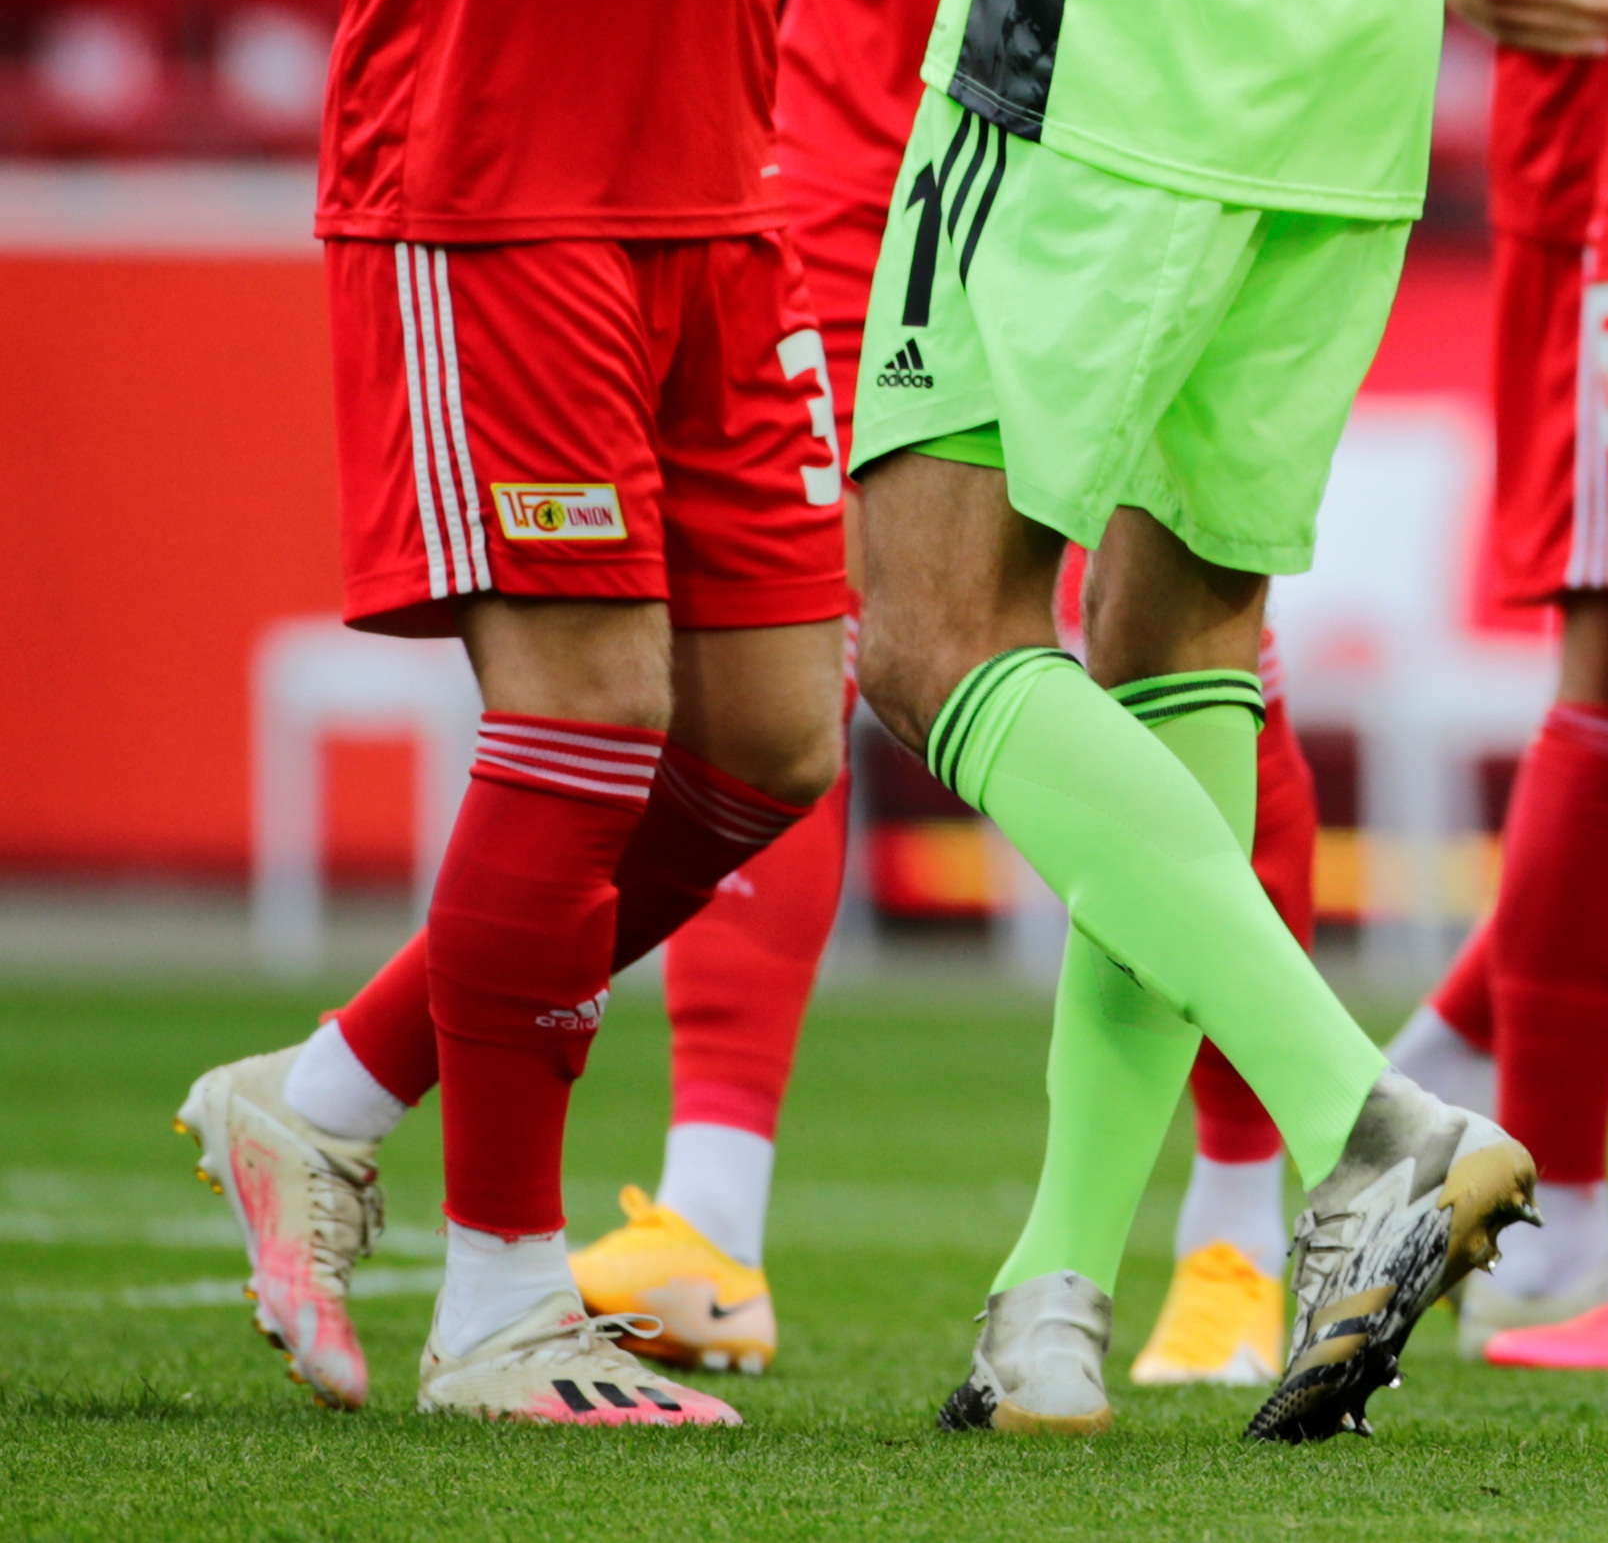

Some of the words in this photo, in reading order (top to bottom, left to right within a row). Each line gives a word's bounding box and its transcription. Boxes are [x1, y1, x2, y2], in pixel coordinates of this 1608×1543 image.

[904, 160, 943, 328] 1
[877, 369, 934, 389] adidas
[566, 506, 614, 527] UNION
